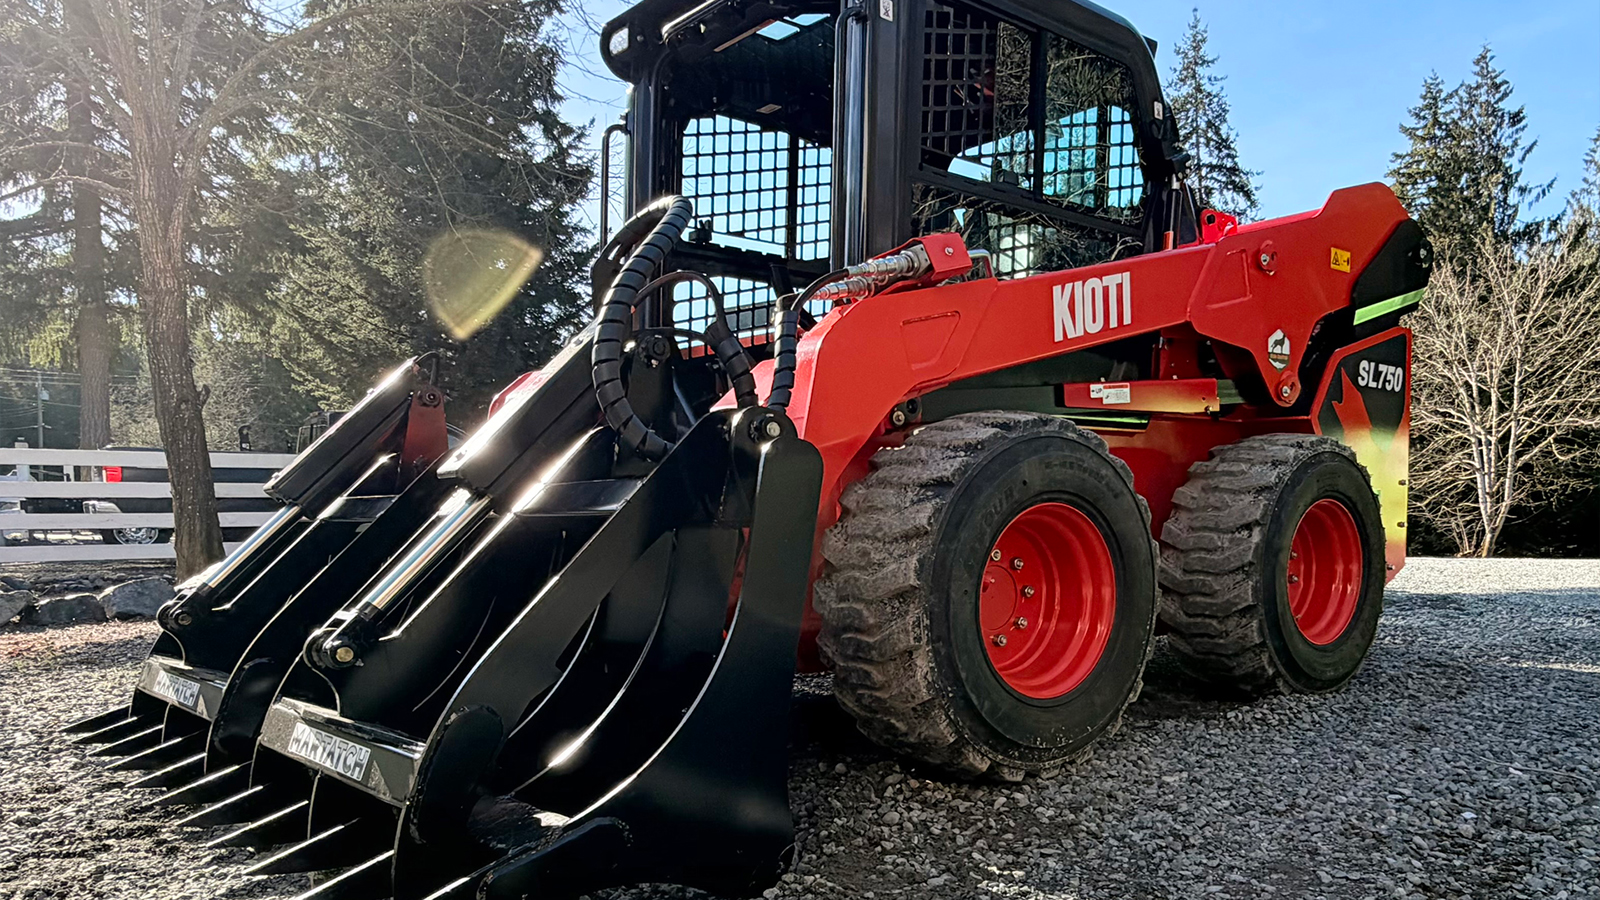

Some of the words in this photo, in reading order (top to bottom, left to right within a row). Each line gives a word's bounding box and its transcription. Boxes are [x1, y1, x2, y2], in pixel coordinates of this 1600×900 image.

[1052, 271, 1132, 343] KIOTI
[1357, 359, 1404, 392] SL750
[155, 671, 199, 705] MARTATCH
[290, 723, 369, 780] MARTATCH
